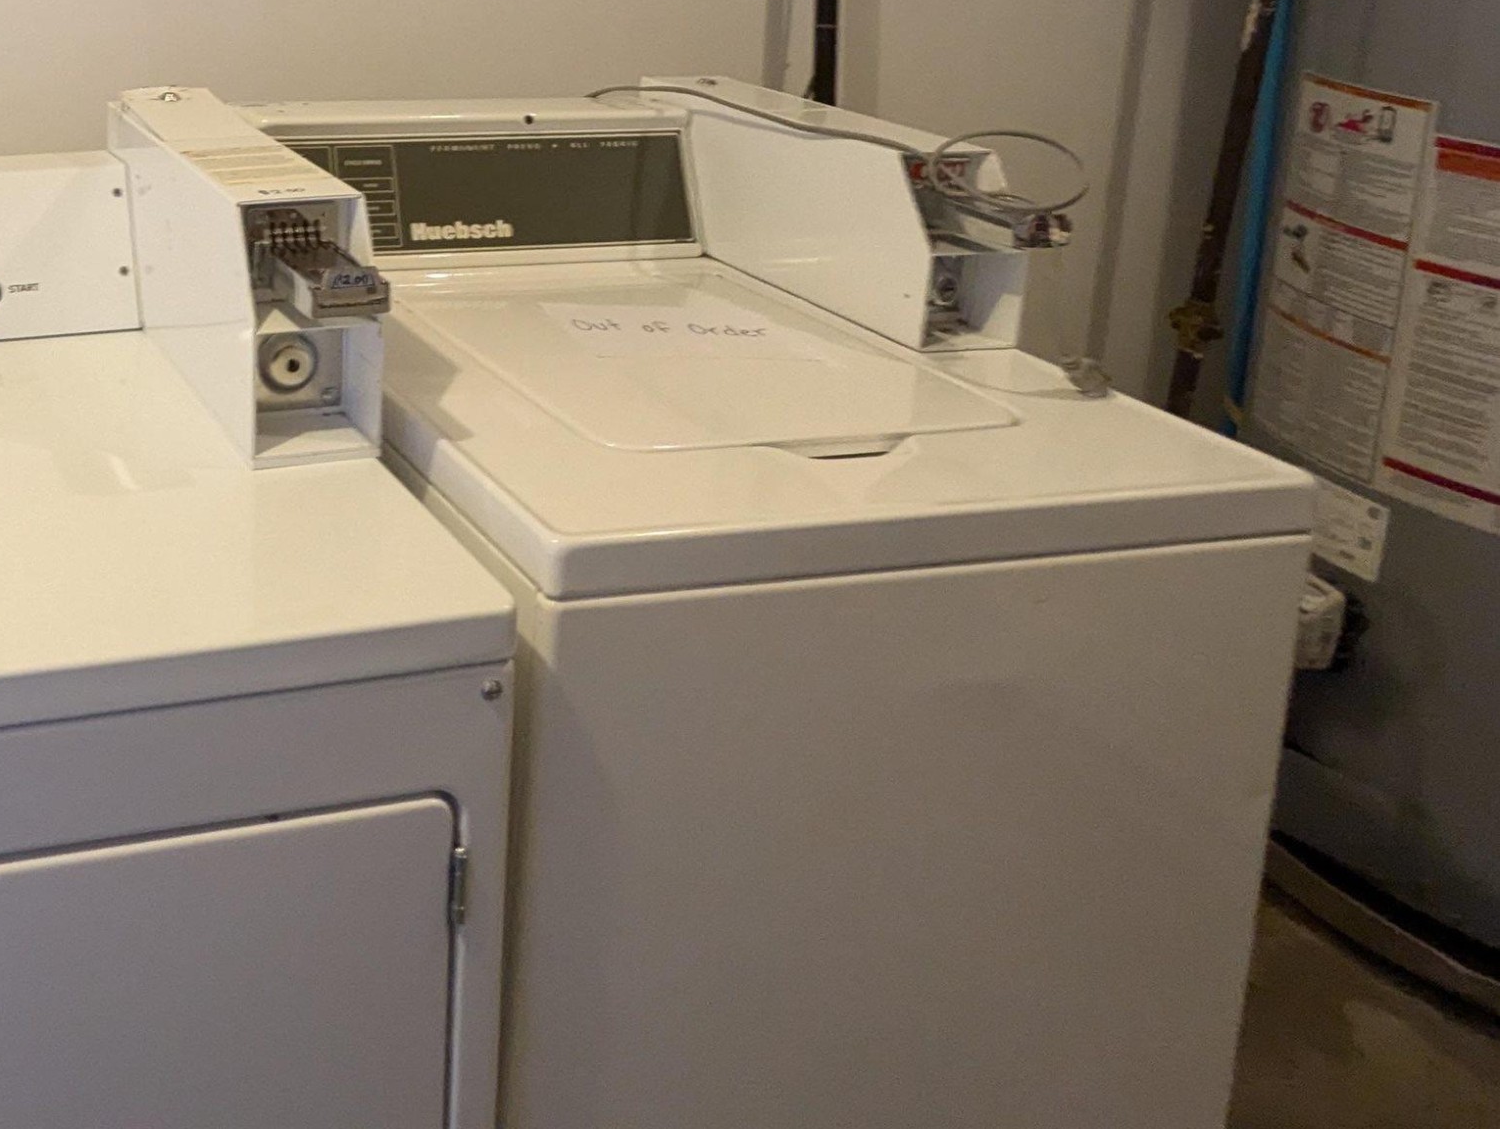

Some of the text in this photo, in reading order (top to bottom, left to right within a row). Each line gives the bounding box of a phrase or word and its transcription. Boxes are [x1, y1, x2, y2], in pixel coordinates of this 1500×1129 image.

[409, 219, 515, 241] Huebsch
[7, 282, 40, 293] START
[571, 319, 622, 331] Out
[687, 323, 767, 337] Order
